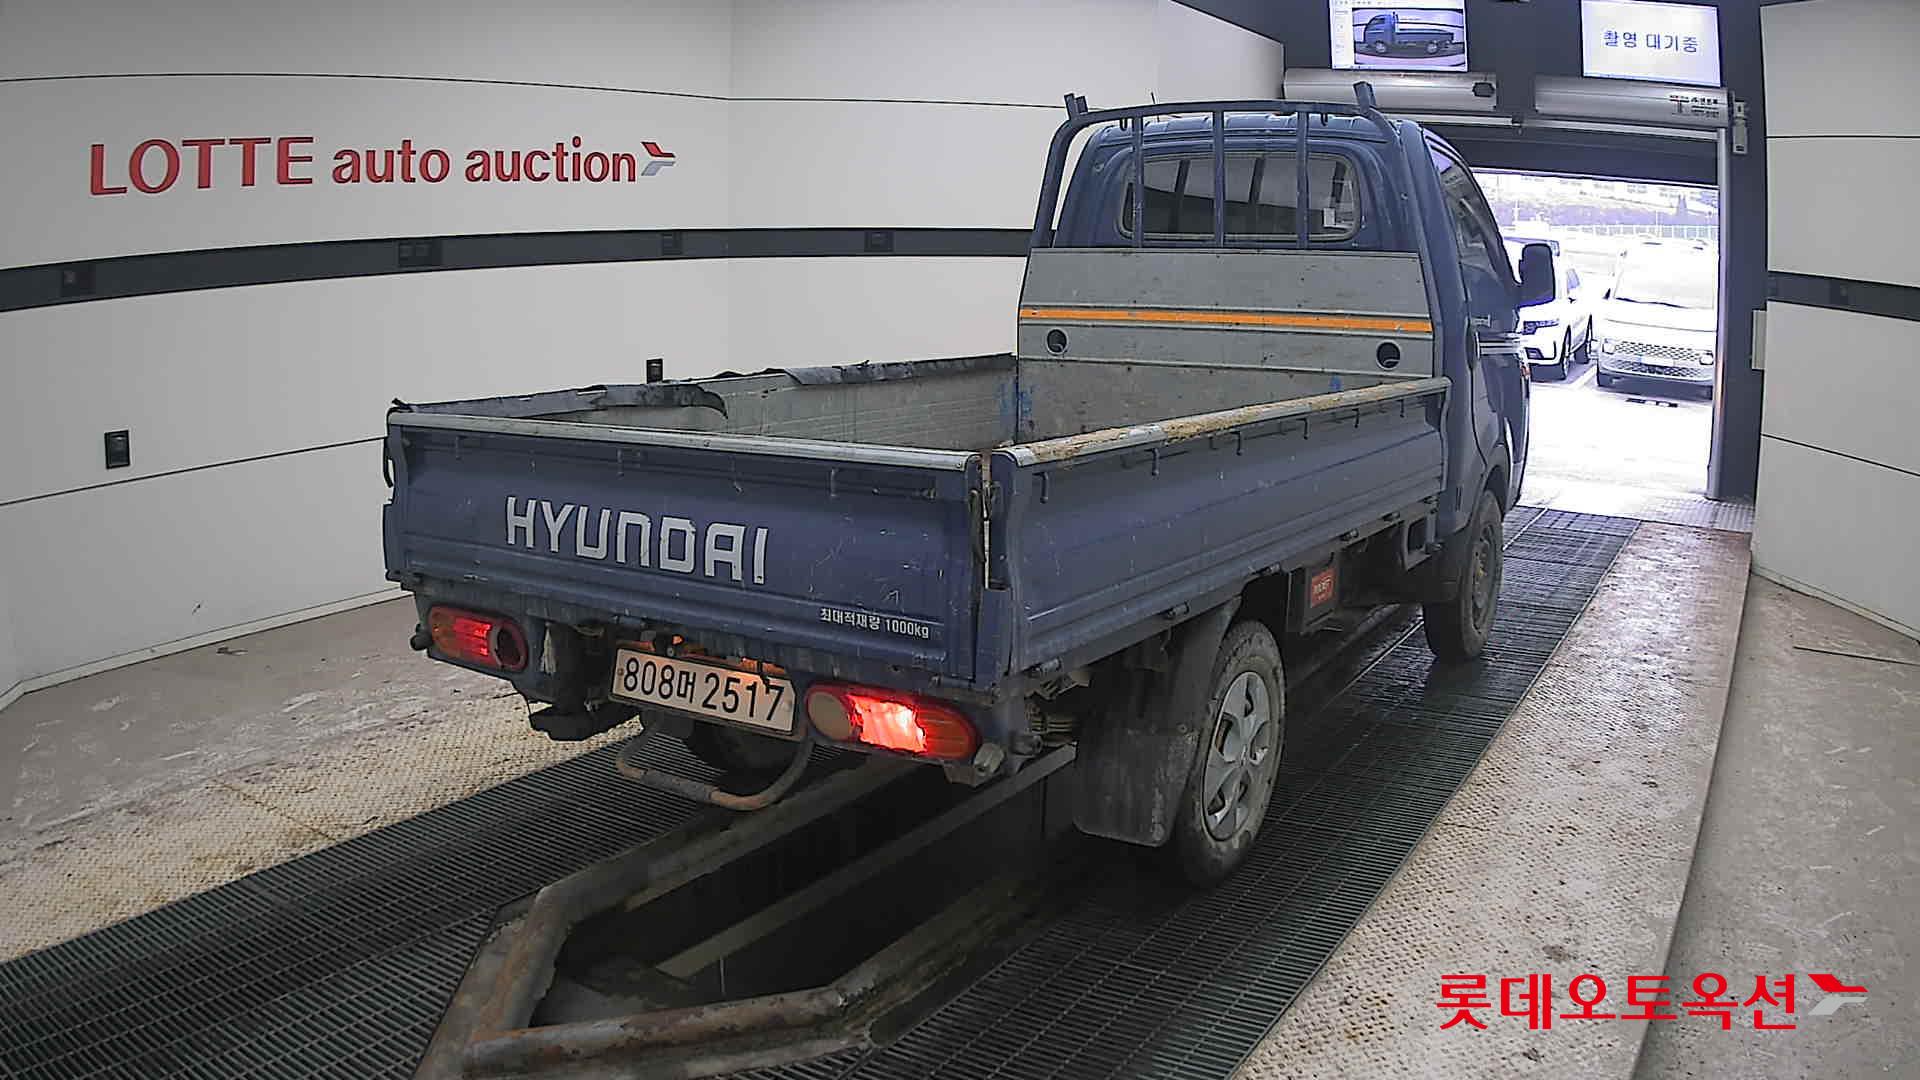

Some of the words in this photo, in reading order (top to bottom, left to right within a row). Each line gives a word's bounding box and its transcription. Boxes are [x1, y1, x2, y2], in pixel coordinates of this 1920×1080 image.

[1603, 30, 1638, 49] 촬영
[1645, 31, 1699, 53] 대기중
[90, 135, 315, 197] LOTTE
[331, 138, 451, 184] auto
[463, 135, 638, 184] auction
[505, 496, 769, 586] HYUNDAI
[819, 607, 881, 631] 최대적재량
[885, 618, 929, 639] 1000kg
[701, 671, 785, 722] 2517
